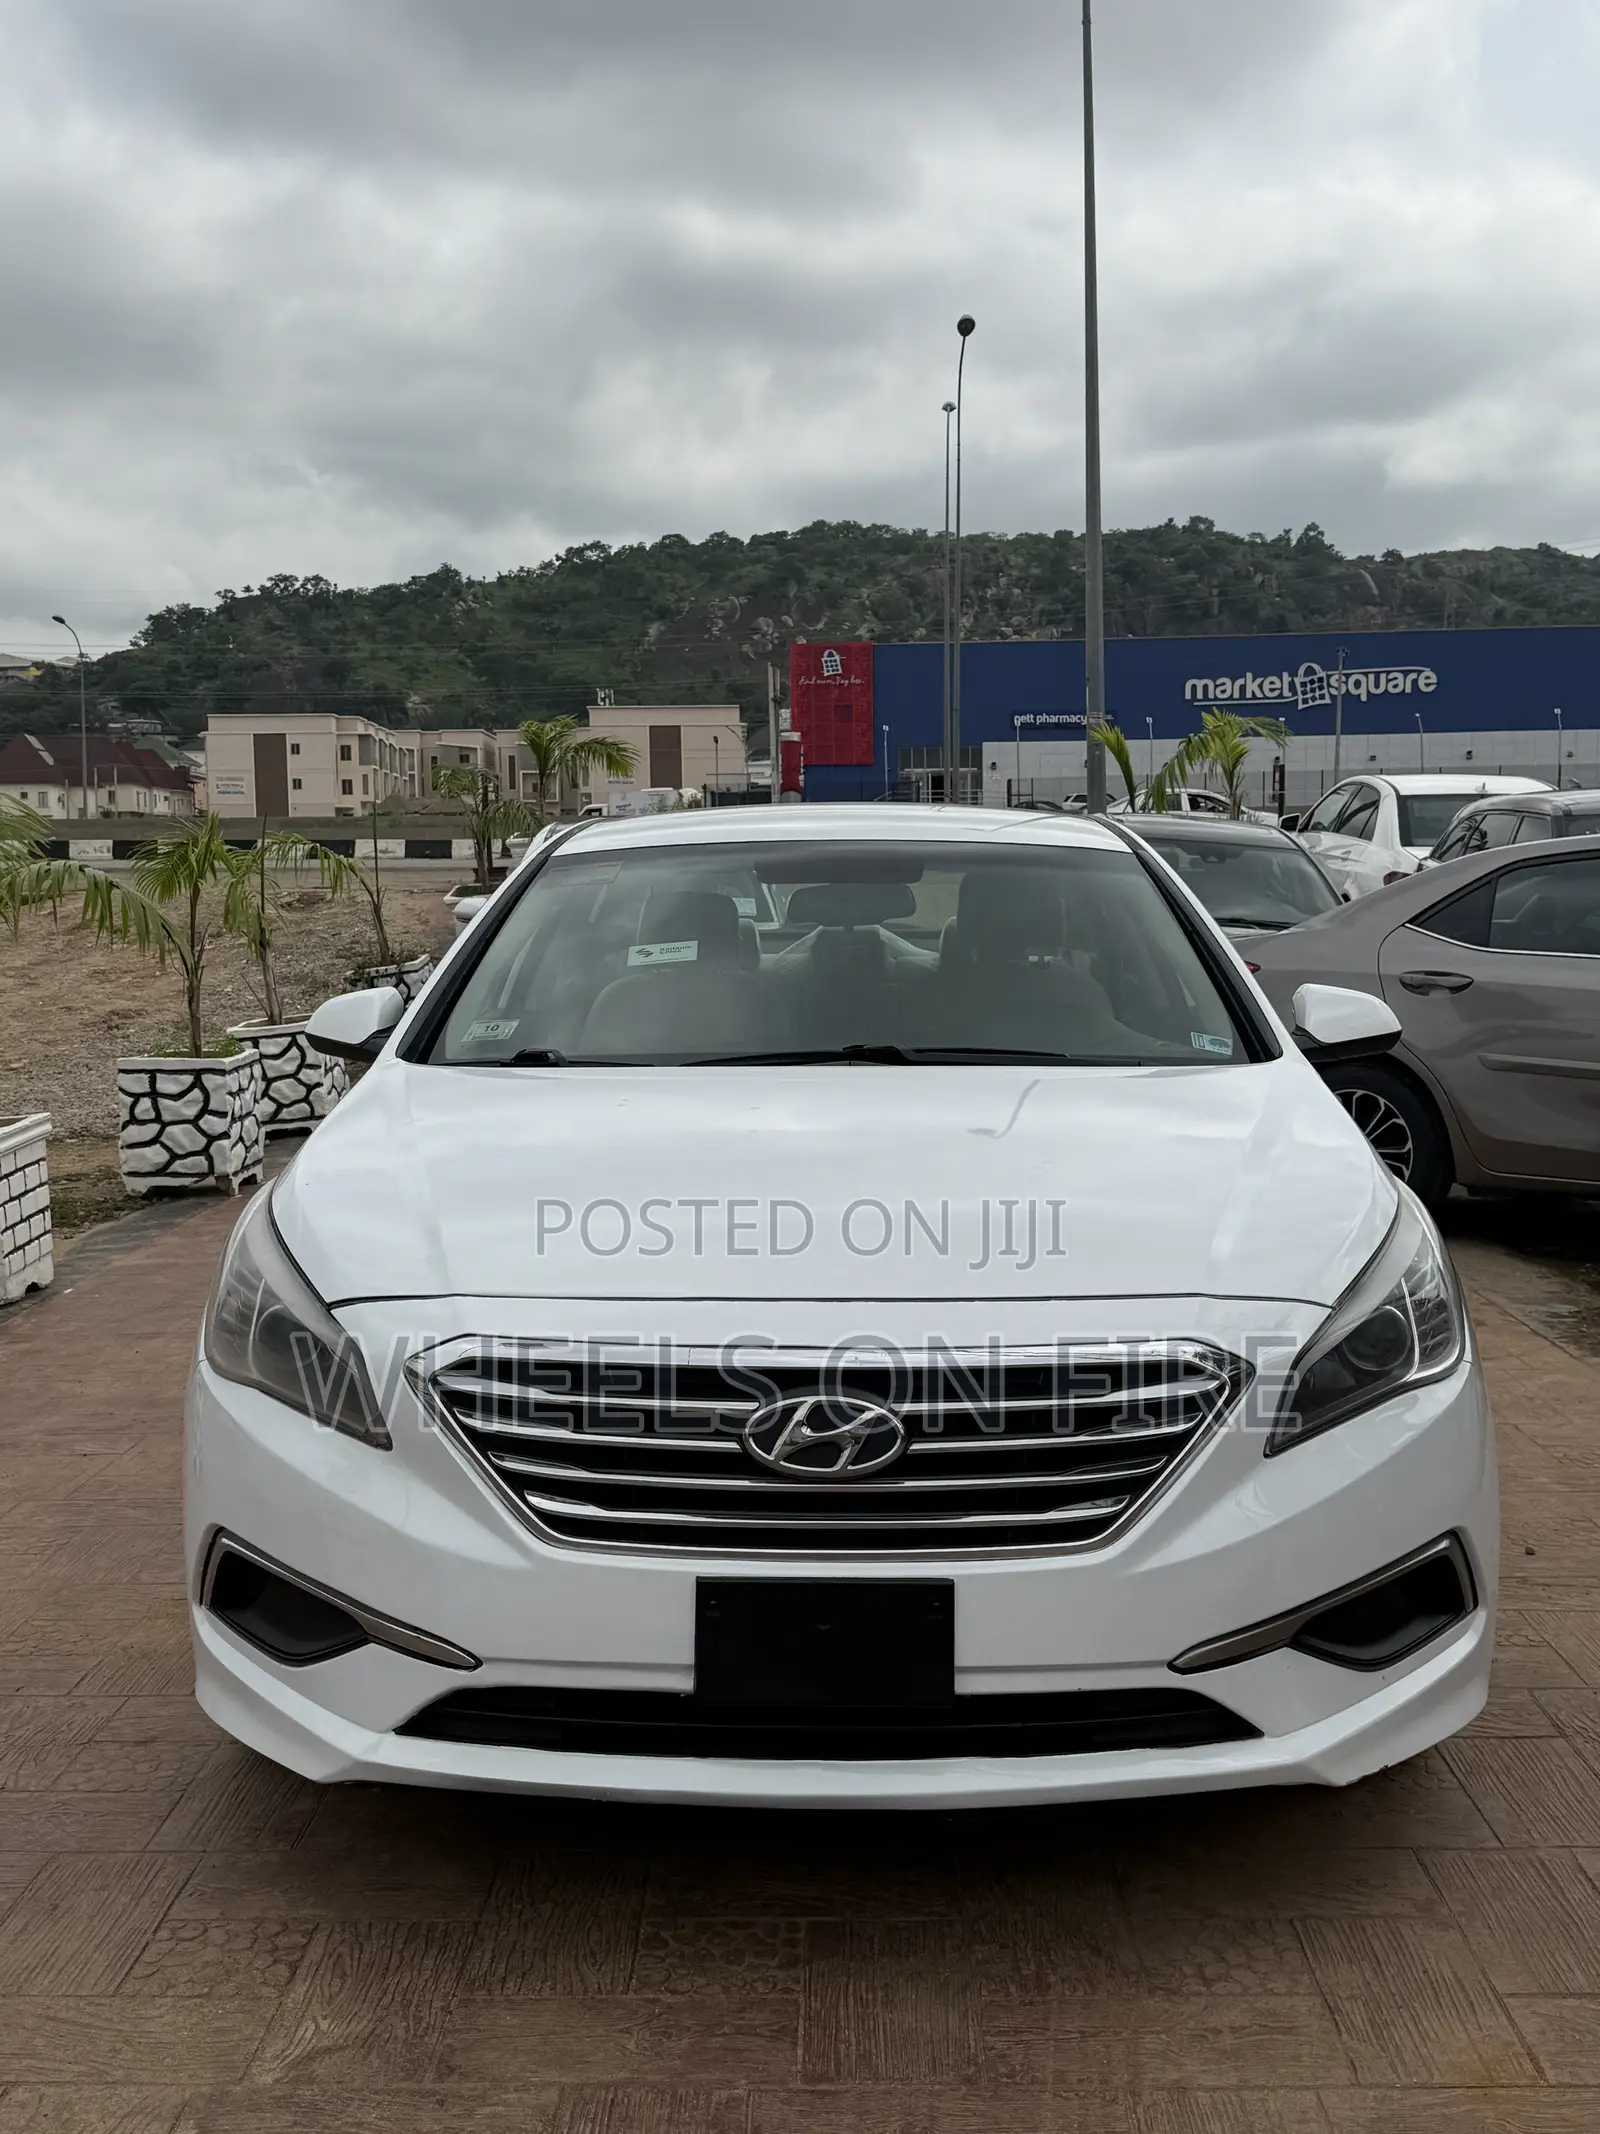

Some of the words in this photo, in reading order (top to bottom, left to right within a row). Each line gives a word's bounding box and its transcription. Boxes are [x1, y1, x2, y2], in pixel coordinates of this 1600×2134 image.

[1185, 672, 1291, 700] market
[1328, 670, 1438, 702] square
[1036, 713, 1088, 725] pharmacy
